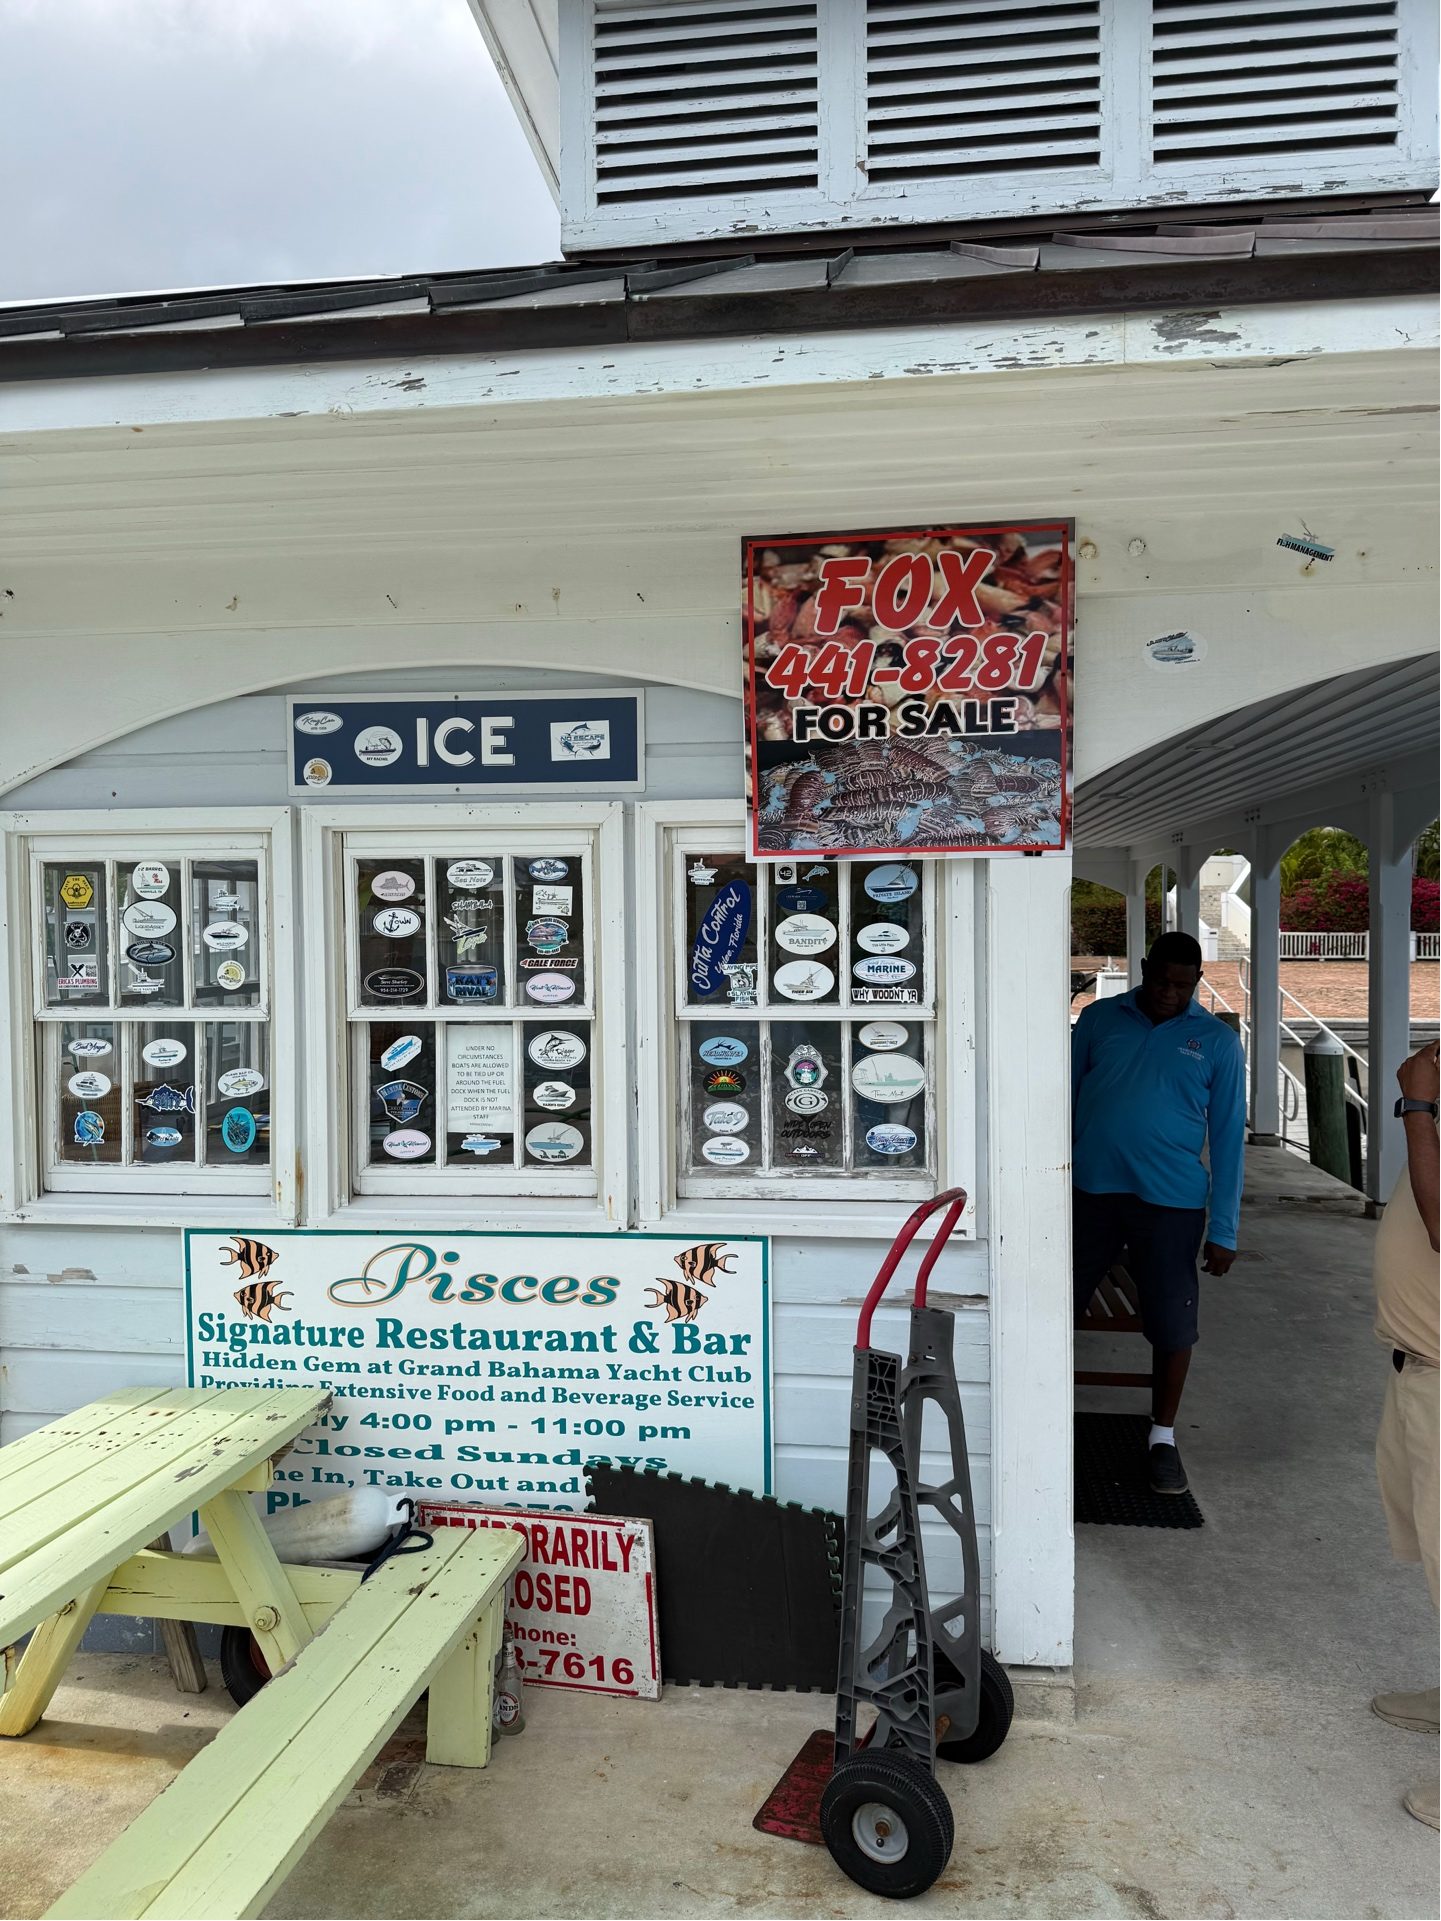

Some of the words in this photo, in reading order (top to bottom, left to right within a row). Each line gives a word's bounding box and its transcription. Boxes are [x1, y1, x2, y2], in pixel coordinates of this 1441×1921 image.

[815, 549, 995, 635] FOX
[766, 632, 1048, 699] 441-8281
[793, 702, 889, 742] FOR
[898, 698, 1018, 738] SALE
[416, 716, 516, 767] ICE
[701, 887, 741, 945] Control
[728, 913, 743, 948] Florida
[550, 959, 577, 967] FORCE
[867, 965, 906, 974] MARINE
[454, 986, 489, 997] RIVAL
[852, 989, 869, 999] WHY
[907, 989, 917, 1001] YA
[799, 1096, 813, 1106] G
[781, 1130, 830, 1139] OUTDOORS
[808, 1120, 832, 1129] OPEN
[328, 1243, 621, 1308] Pisces
[198, 1312, 365, 1352] Signature
[376, 1318, 618, 1353] Restaurant
[628, 1321, 660, 1354] &
[672, 1323, 751, 1356] Bar
[202, 1351, 298, 1371] Hidden
[303, 1356, 362, 1373] Gem
[367, 1359, 393, 1375] at
[398, 1358, 481, 1377] Grand
[488, 1361, 600, 1380] Bahama
[606, 1364, 682, 1382] Yacht
[688, 1366, 752, 1383] Club
[320, 1381, 432, 1400] Extensive
[438, 1384, 494, 1402] Food
[500, 1386, 546, 1403] and
[552, 1387, 662, 1411] Beverage
[667, 1389, 755, 1408] Service
[360, 1413, 432, 1431] 4:00
[445, 1418, 496, 1435] pm
[531, 1417, 626, 1437] 11:00
[638, 1424, 691, 1442] pm
[312, 1467, 354, 1488] In,
[363, 1469, 443, 1488] Take
[450, 1473, 510, 1491] Out
[516, 1477, 580, 1493] and
